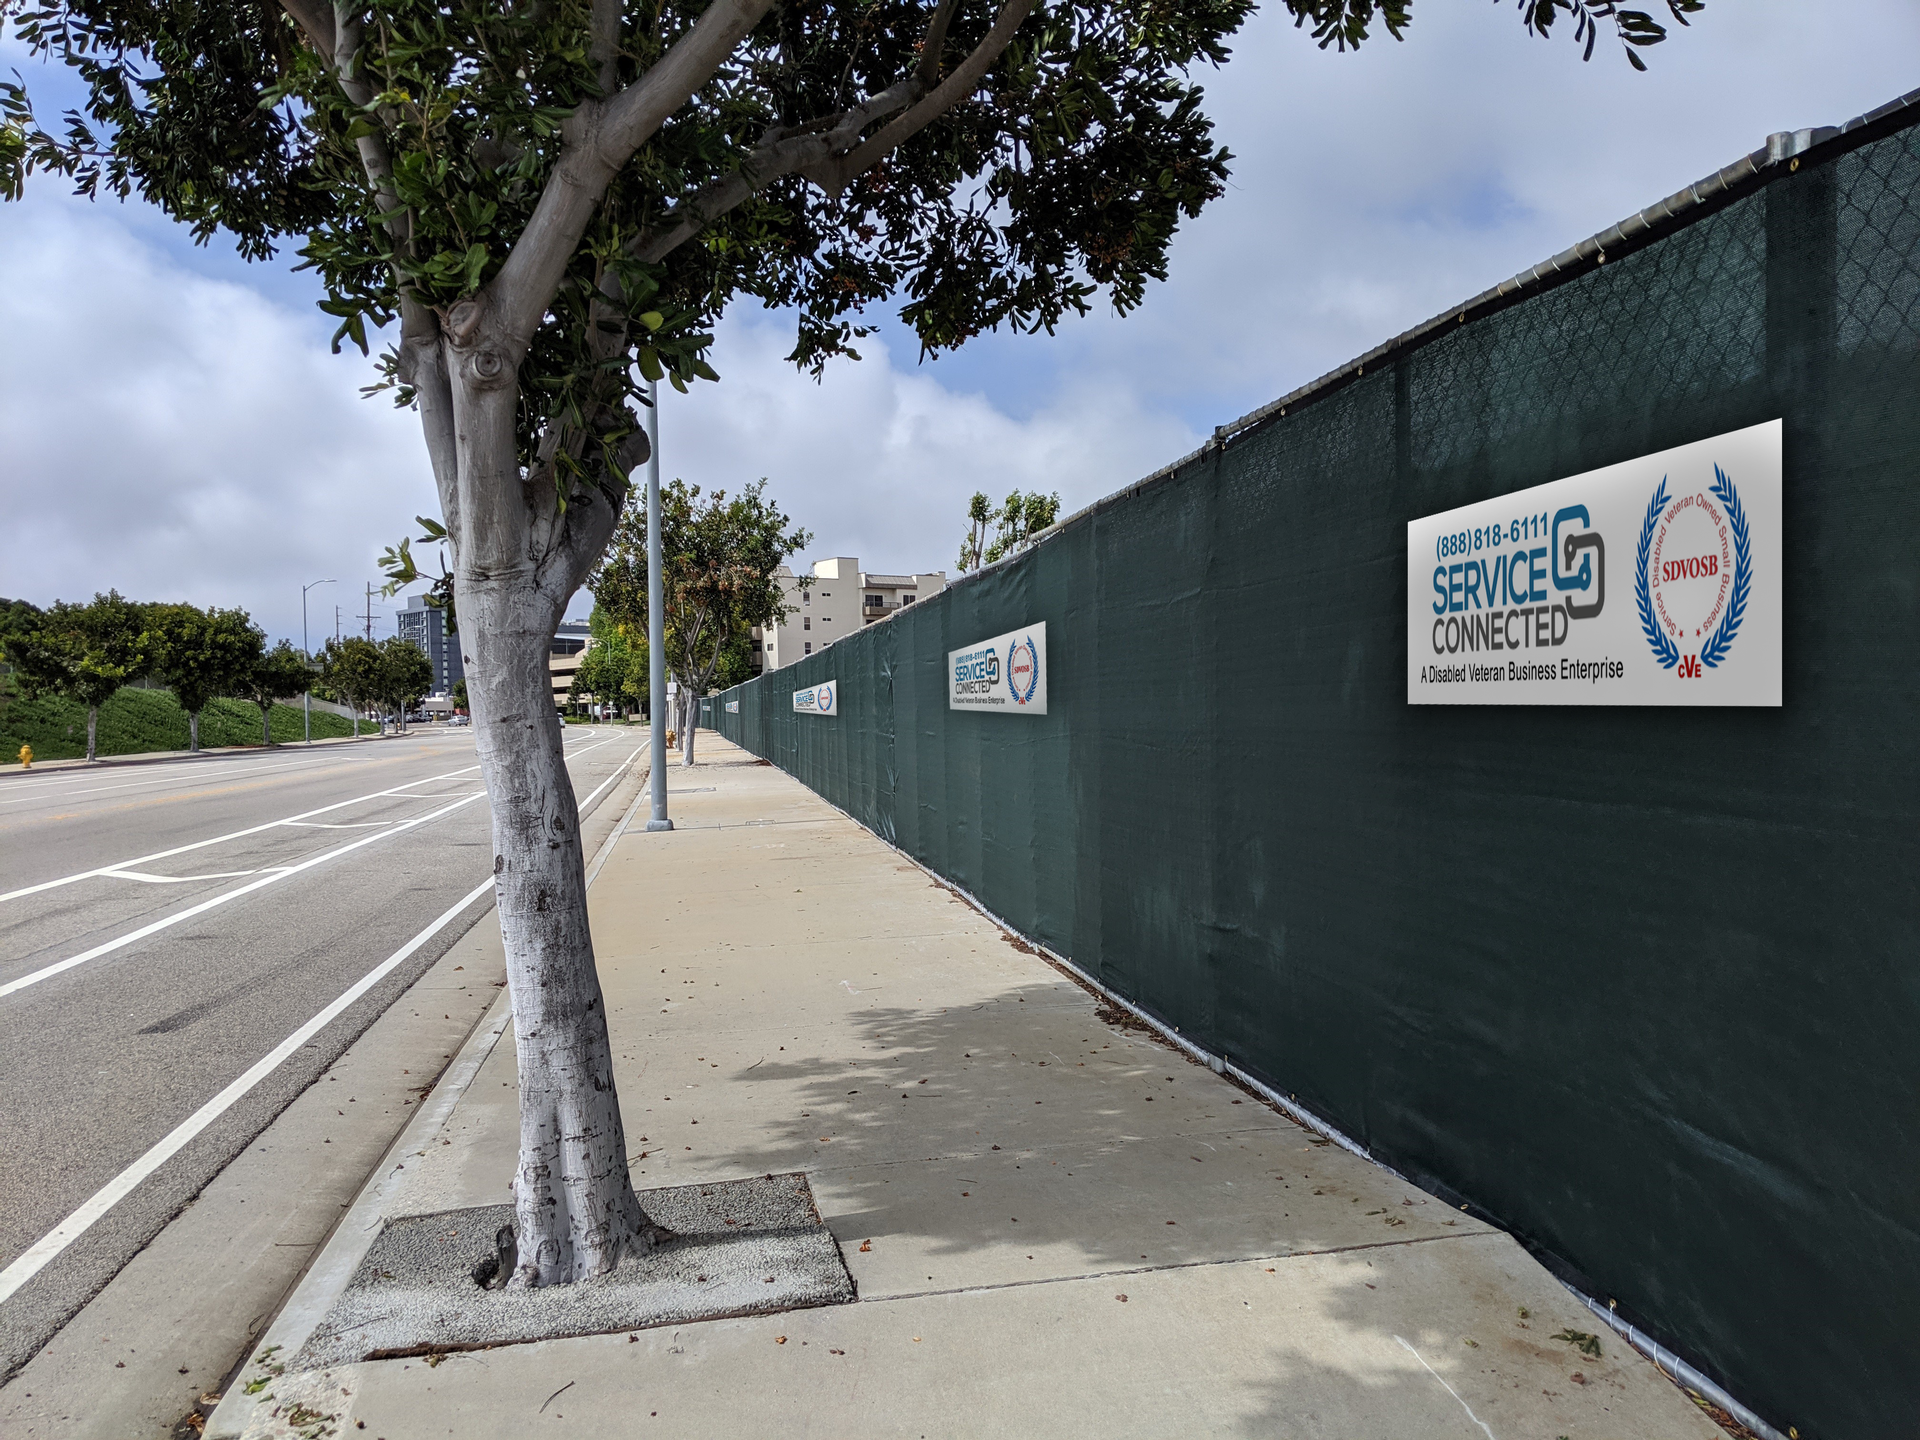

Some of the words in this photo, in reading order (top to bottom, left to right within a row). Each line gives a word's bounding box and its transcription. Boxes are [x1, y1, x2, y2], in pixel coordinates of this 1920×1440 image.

[1664, 495, 1694, 524] Veteran
[1696, 493, 1722, 526] Owned
[1436, 512, 1548, 562] (888)818-6111
[1652, 524, 1667, 588] Disabled
[1718, 525, 1731, 568] Small
[1432, 546, 1548, 615] SERVICE
[1662, 554, 1719, 583] SDVOSB
[1655, 591, 1677, 637] Service
[1702, 573, 1730, 632] Business
[1432, 604, 1568, 655] CONNECTED
[955, 661, 985, 682] SERVICE
[1420, 666, 1428, 683] A
[1429, 663, 1466, 683] Disabled
[1468, 661, 1505, 682] Veteran
[1508, 660, 1557, 681] Business
[1560, 656, 1624, 684] Enterprise
[1678, 654, 1702, 679] CVE
[955, 679, 991, 695] CONNECTED
